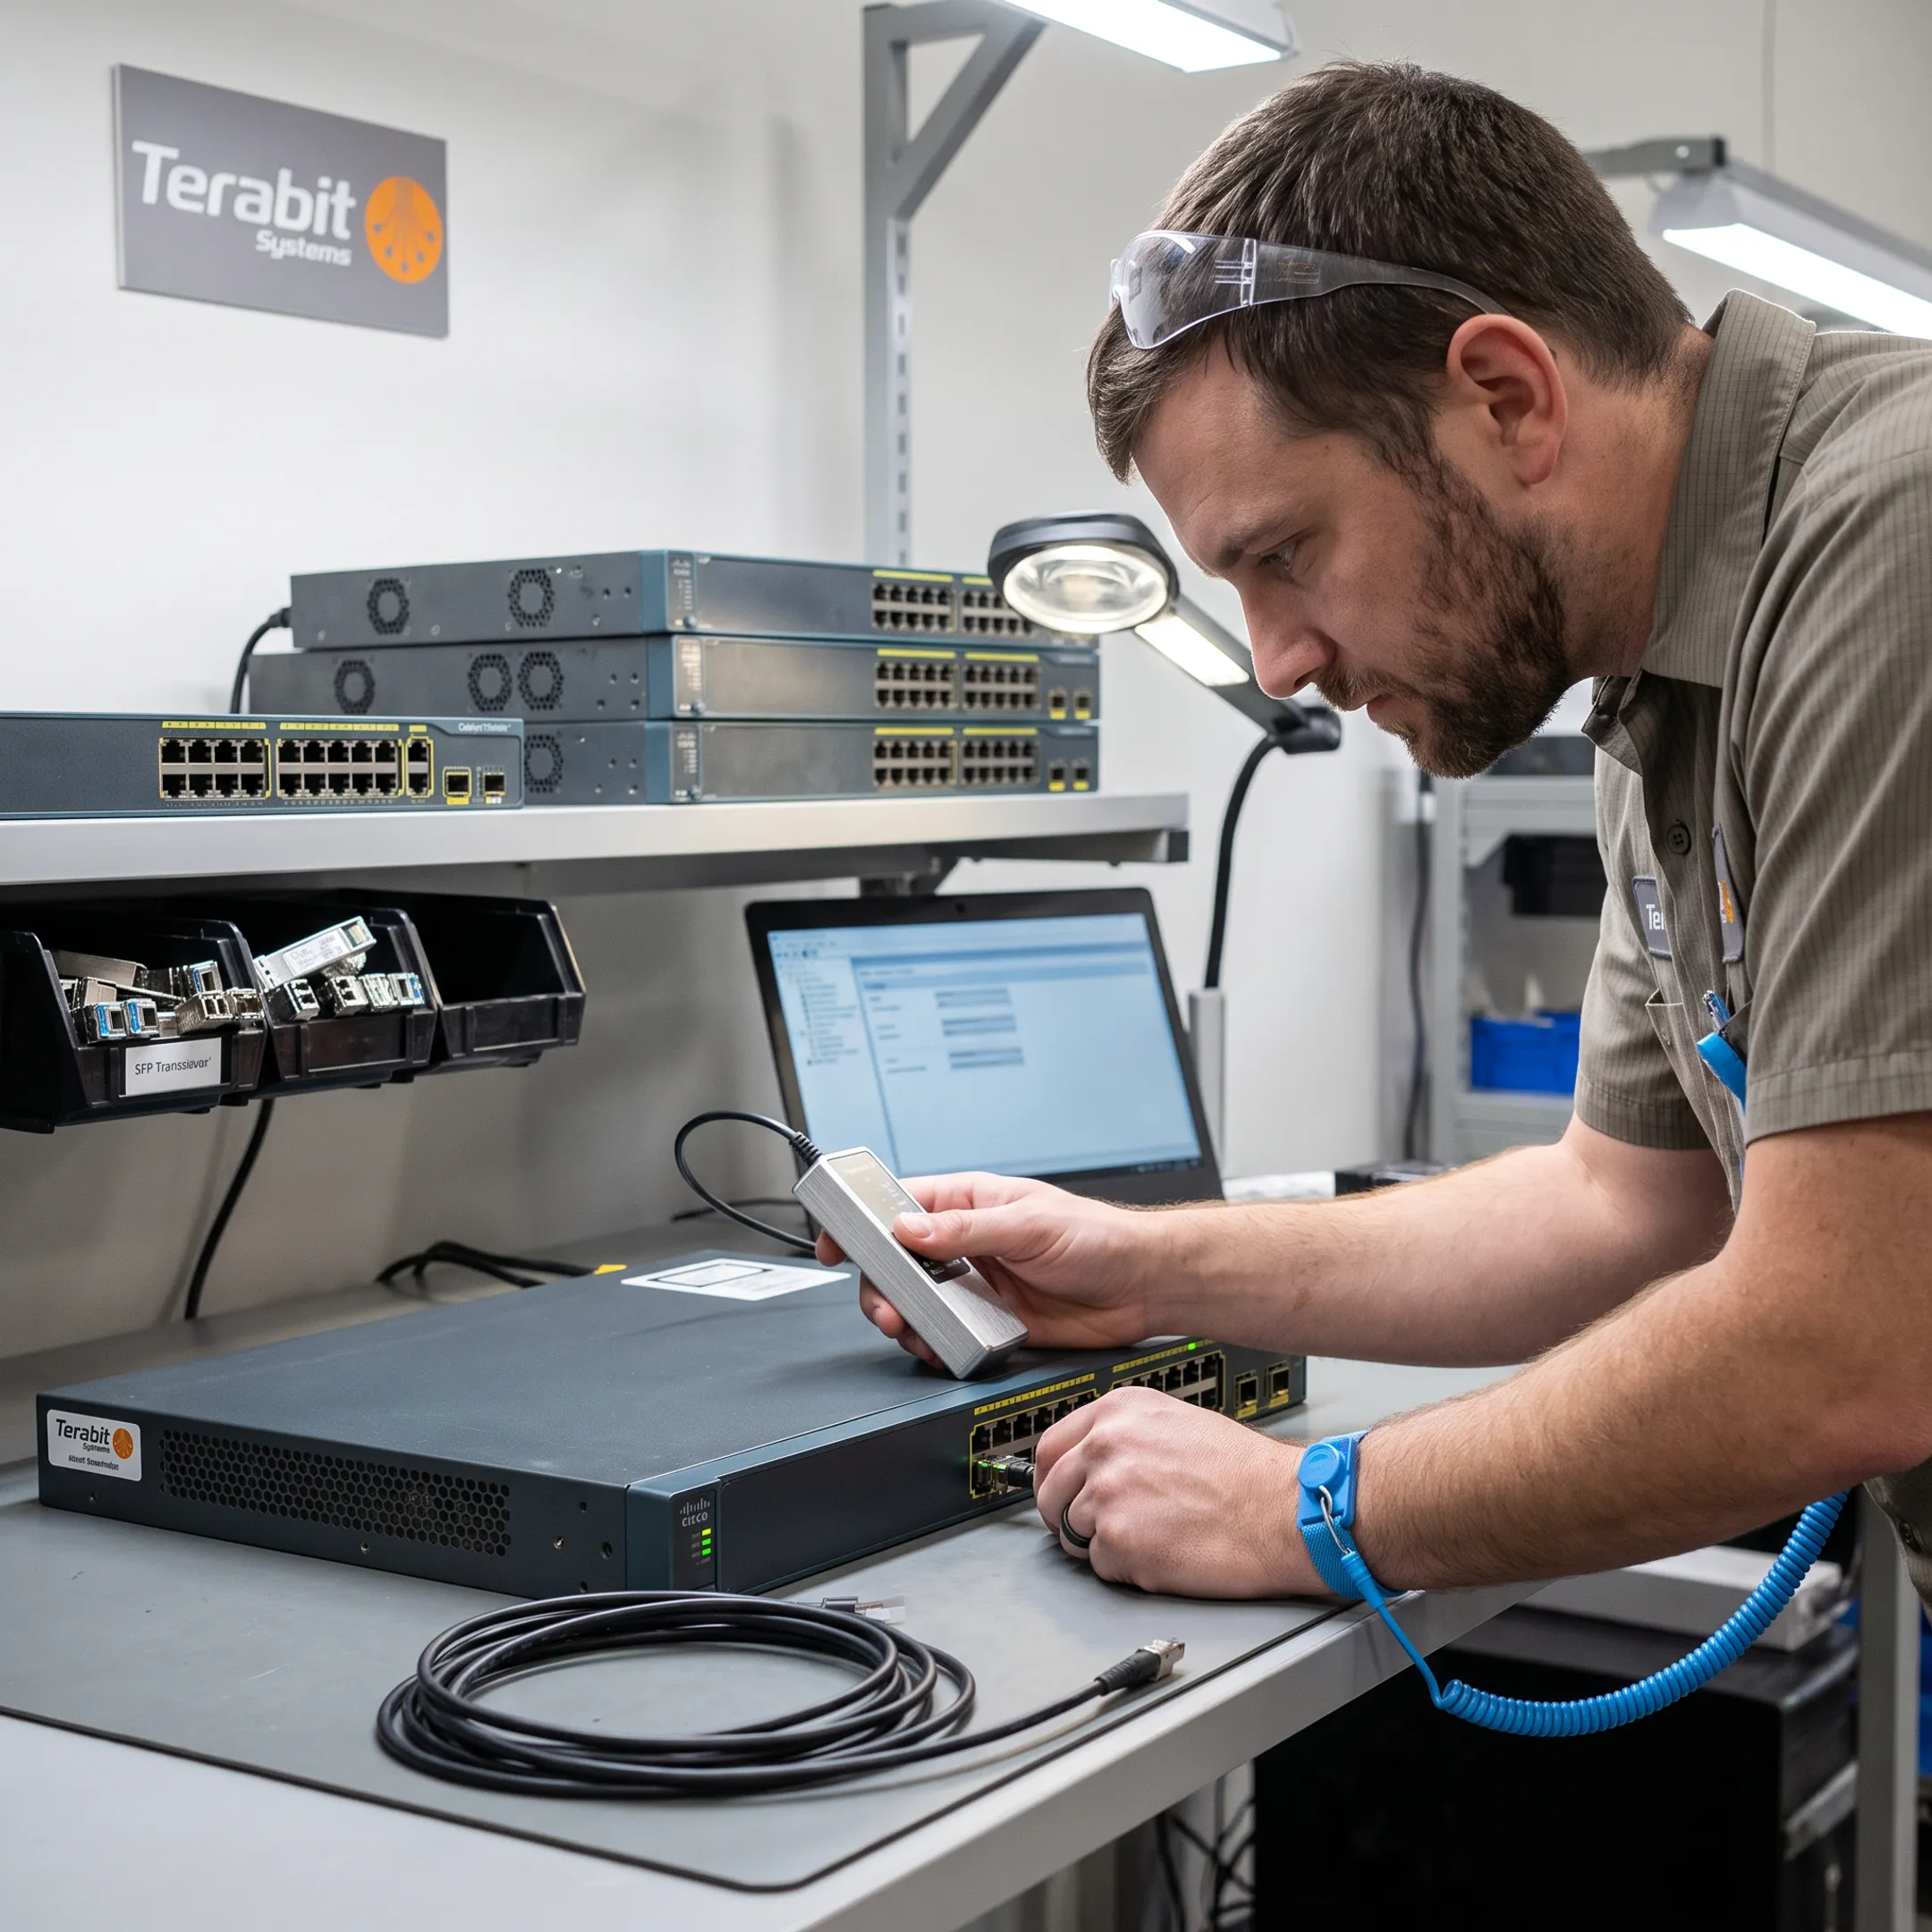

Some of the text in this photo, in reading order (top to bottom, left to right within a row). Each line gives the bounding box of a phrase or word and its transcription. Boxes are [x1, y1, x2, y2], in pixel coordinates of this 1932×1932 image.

[131, 140, 356, 241] Terabit
[255, 229, 352, 267] Systems
[134, 1062, 154, 1075] SFP
[55, 1418, 111, 1445] Terabit
